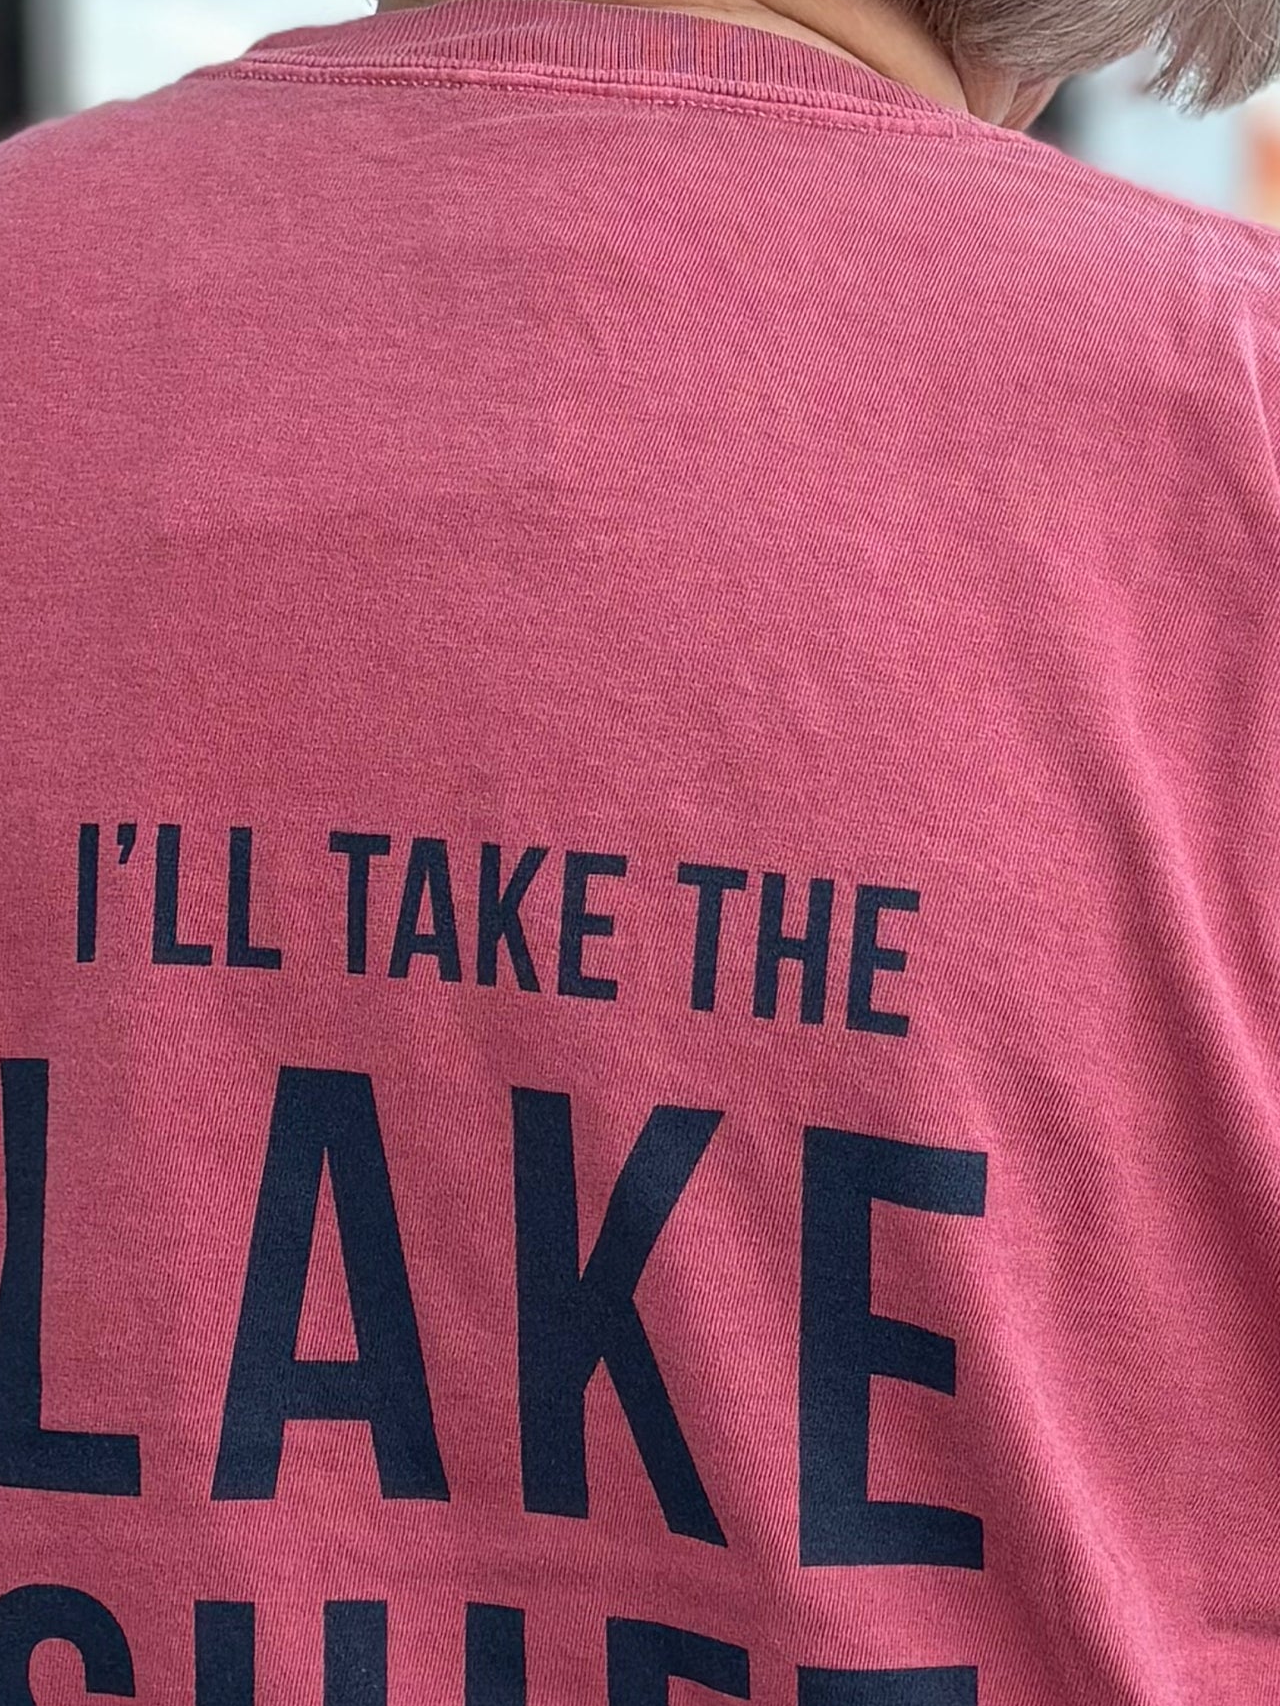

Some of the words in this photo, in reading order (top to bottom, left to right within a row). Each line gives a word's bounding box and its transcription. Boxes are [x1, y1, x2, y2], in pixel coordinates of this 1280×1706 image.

[77, 823, 282, 970] I'LL
[330, 831, 627, 1001] TAKE
[678, 862, 920, 1037] THE
